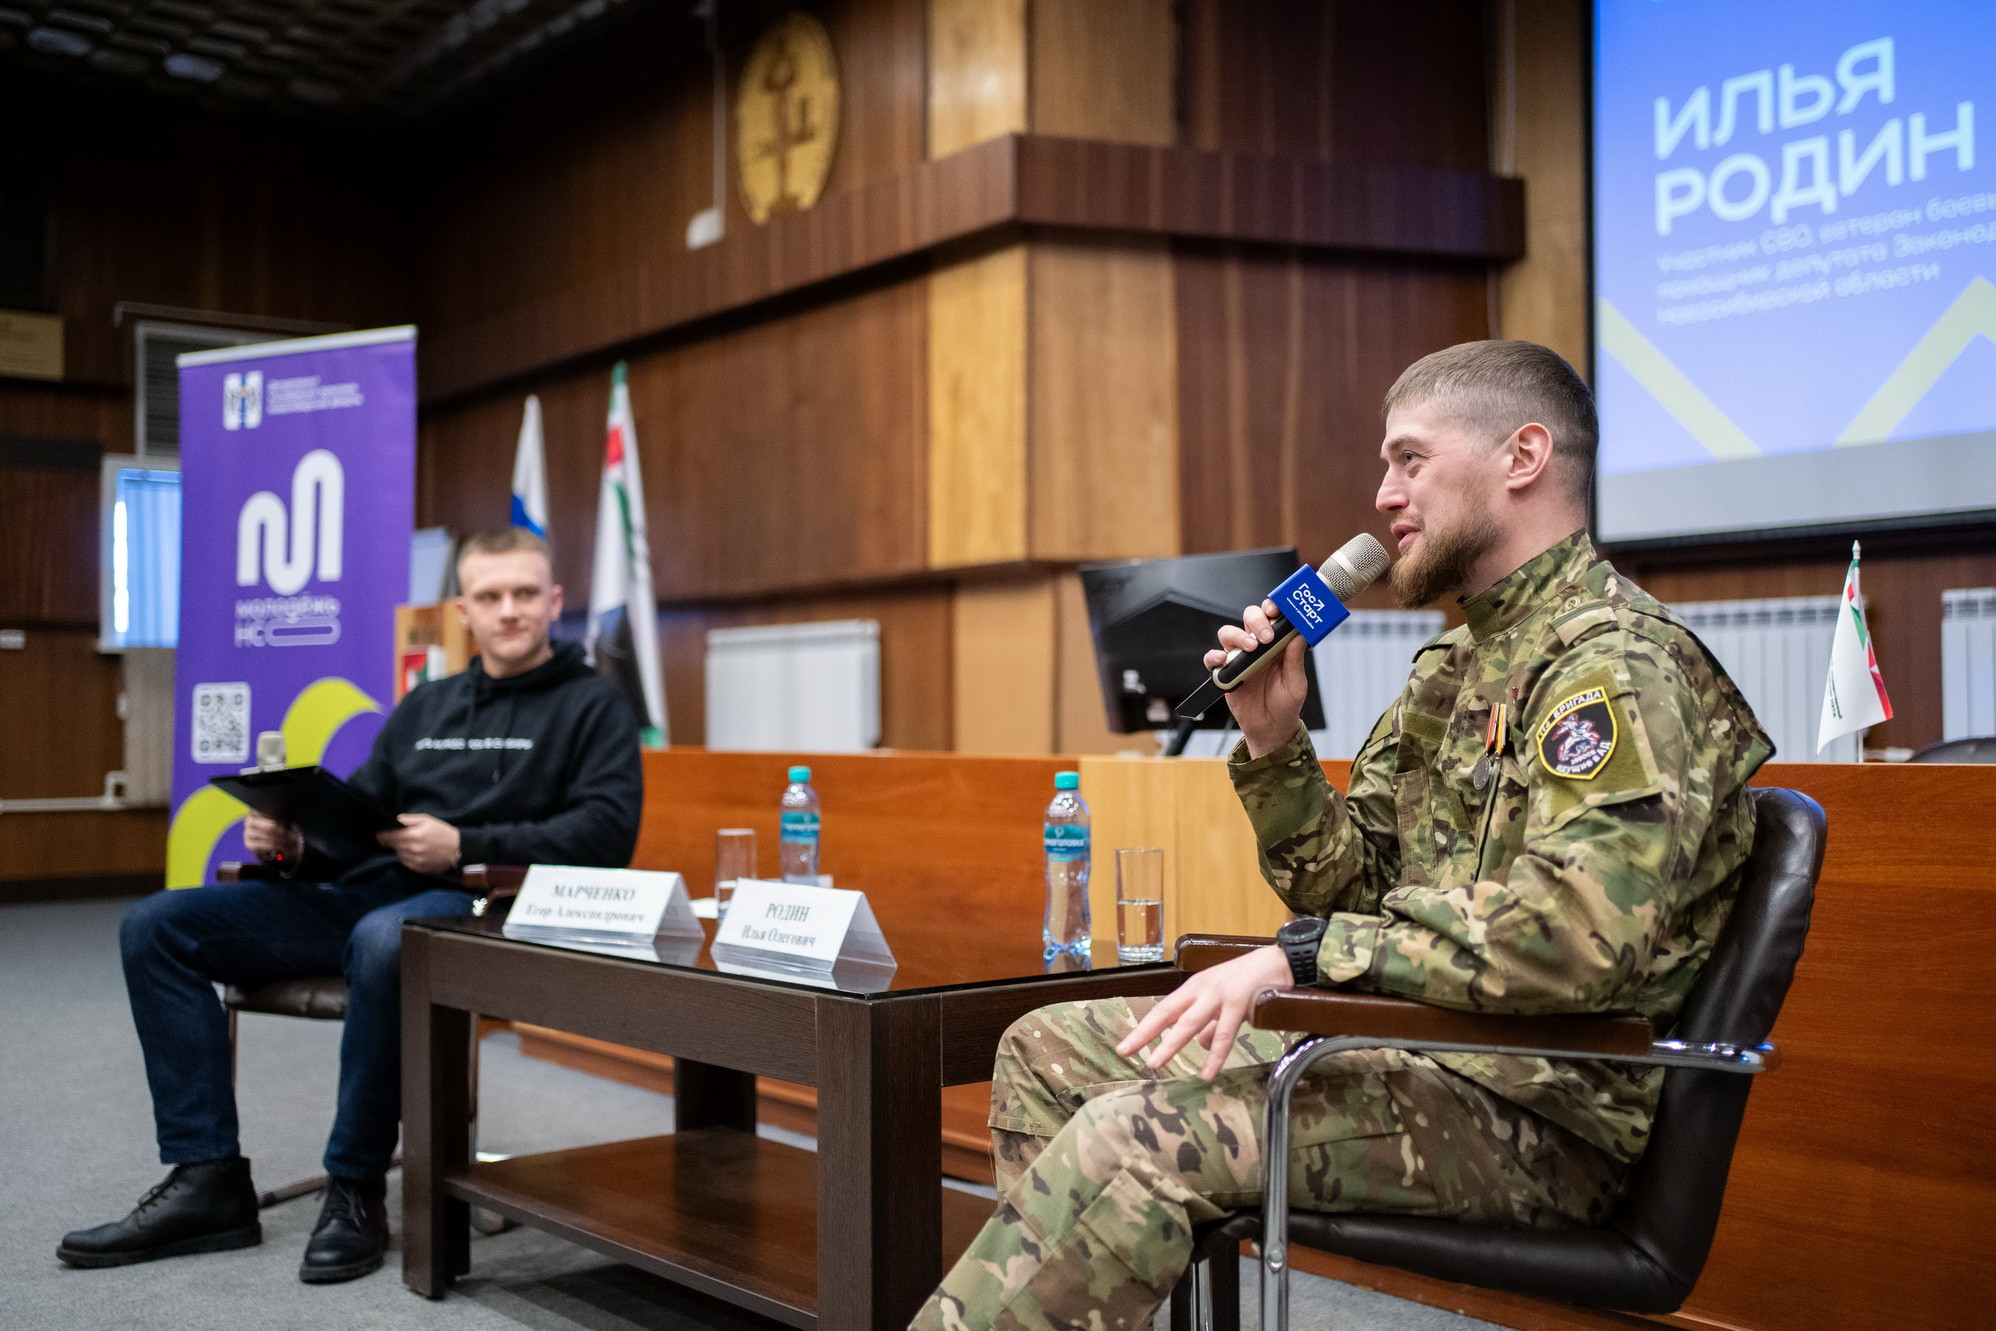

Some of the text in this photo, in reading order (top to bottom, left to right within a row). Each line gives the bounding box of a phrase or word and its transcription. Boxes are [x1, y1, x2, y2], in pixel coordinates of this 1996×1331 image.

[1654, 36, 1895, 161] ИЛЬЯ
[1655, 101, 1975, 236] РОДИН
[1292, 590, 1323, 624] Старт
[1552, 690, 1602, 719] БРИГАДА
[1597, 741, 1612, 757] АД
[553, 884, 636, 901] МАРЧЕНКО
[765, 903, 811, 922] РОДИН
[741, 924, 816, 947] Илья Олегович
